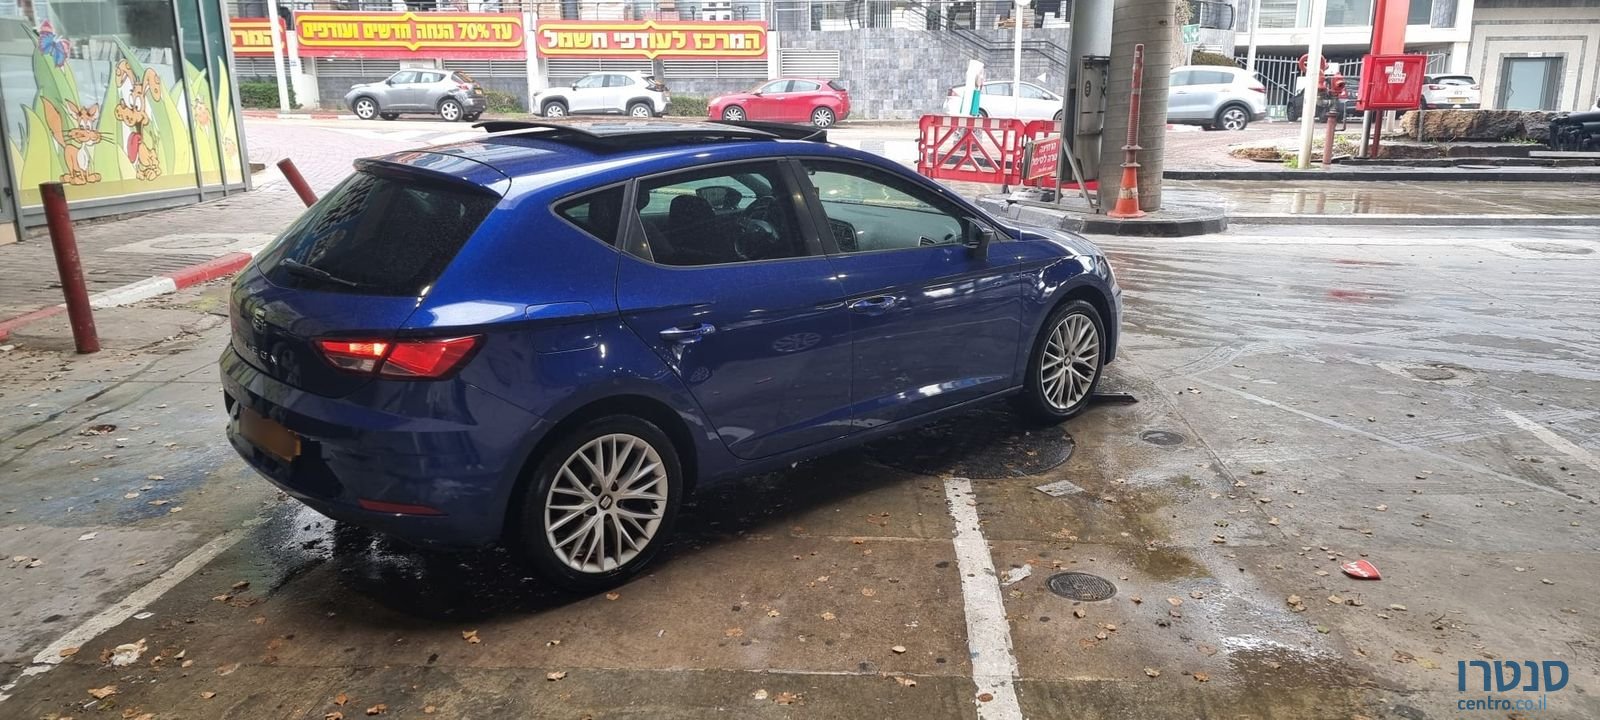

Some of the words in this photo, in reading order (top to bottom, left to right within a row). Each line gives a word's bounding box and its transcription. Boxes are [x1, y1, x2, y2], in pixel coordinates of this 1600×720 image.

[231, 30, 273, 46] המר
[302, 22, 358, 38] ועודפים
[363, 23, 411, 39] חדשים
[416, 23, 455, 39] הנחה
[458, 23, 490, 40] 70%
[491, 23, 512, 39] עד
[544, 29, 608, 49] חשמל
[614, 30, 687, 49] לעודפי
[694, 32, 760, 49] המרכז
